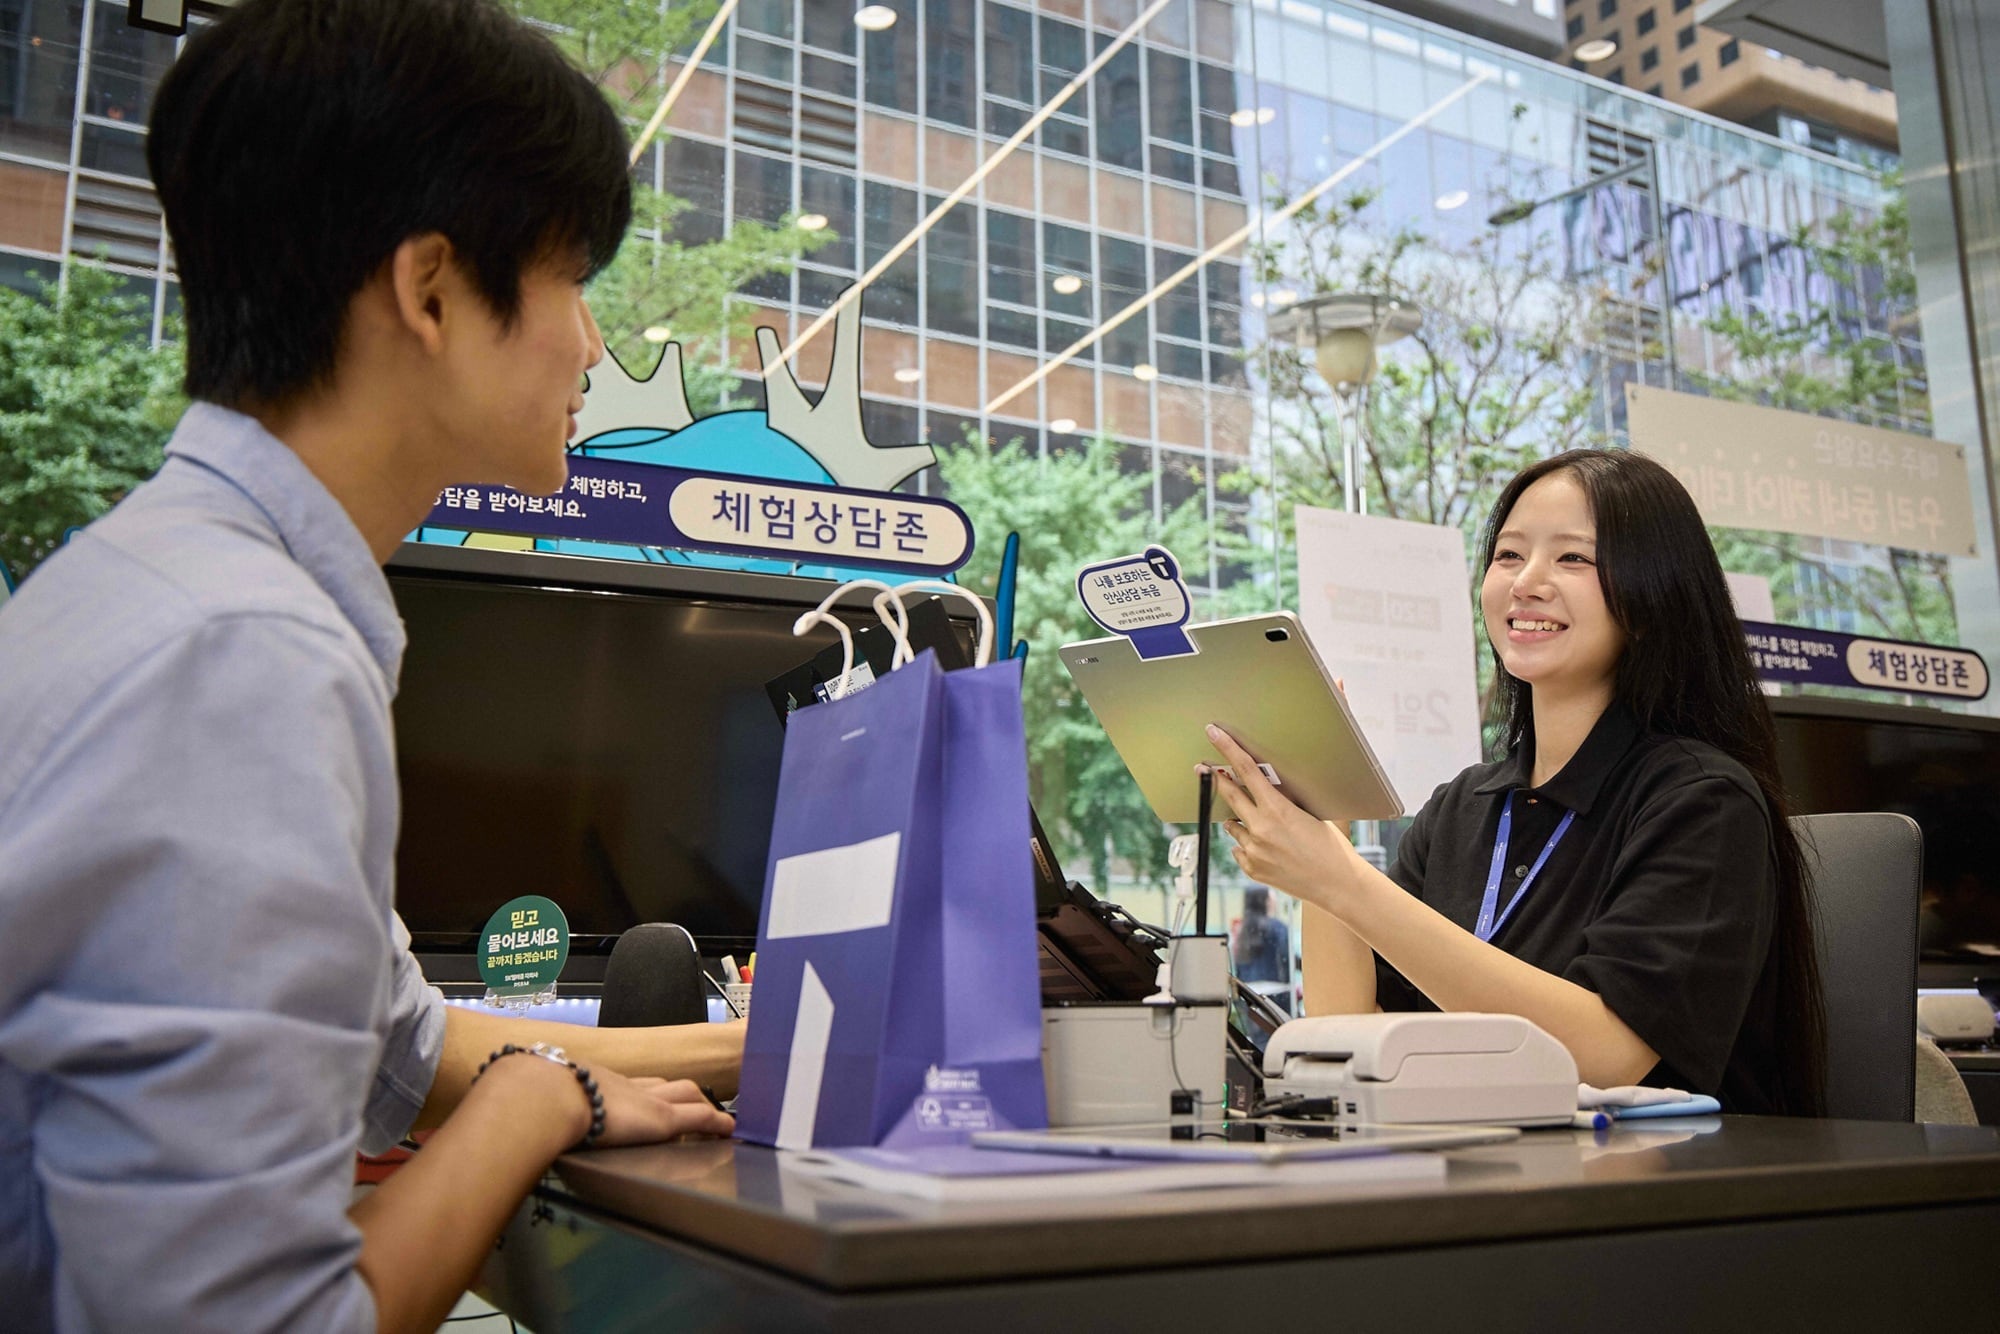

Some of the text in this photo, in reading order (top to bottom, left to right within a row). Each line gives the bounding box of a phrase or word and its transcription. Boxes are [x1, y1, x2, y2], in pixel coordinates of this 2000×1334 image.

[569, 475, 648, 504] 체험하고,
[488, 491, 588, 519] 받아보세요.
[712, 488, 929, 555] 체험상담존
[1093, 568, 1152, 589] 나를 보호하는
[1102, 583, 1162, 606] 안심상담 녹음
[1868, 647, 1970, 689] 체험상담존
[510, 909, 539, 930] 믿고
[486, 927, 560, 954] 물어보세요
[486, 948, 559, 969] 끝까지 돕겠습니다
